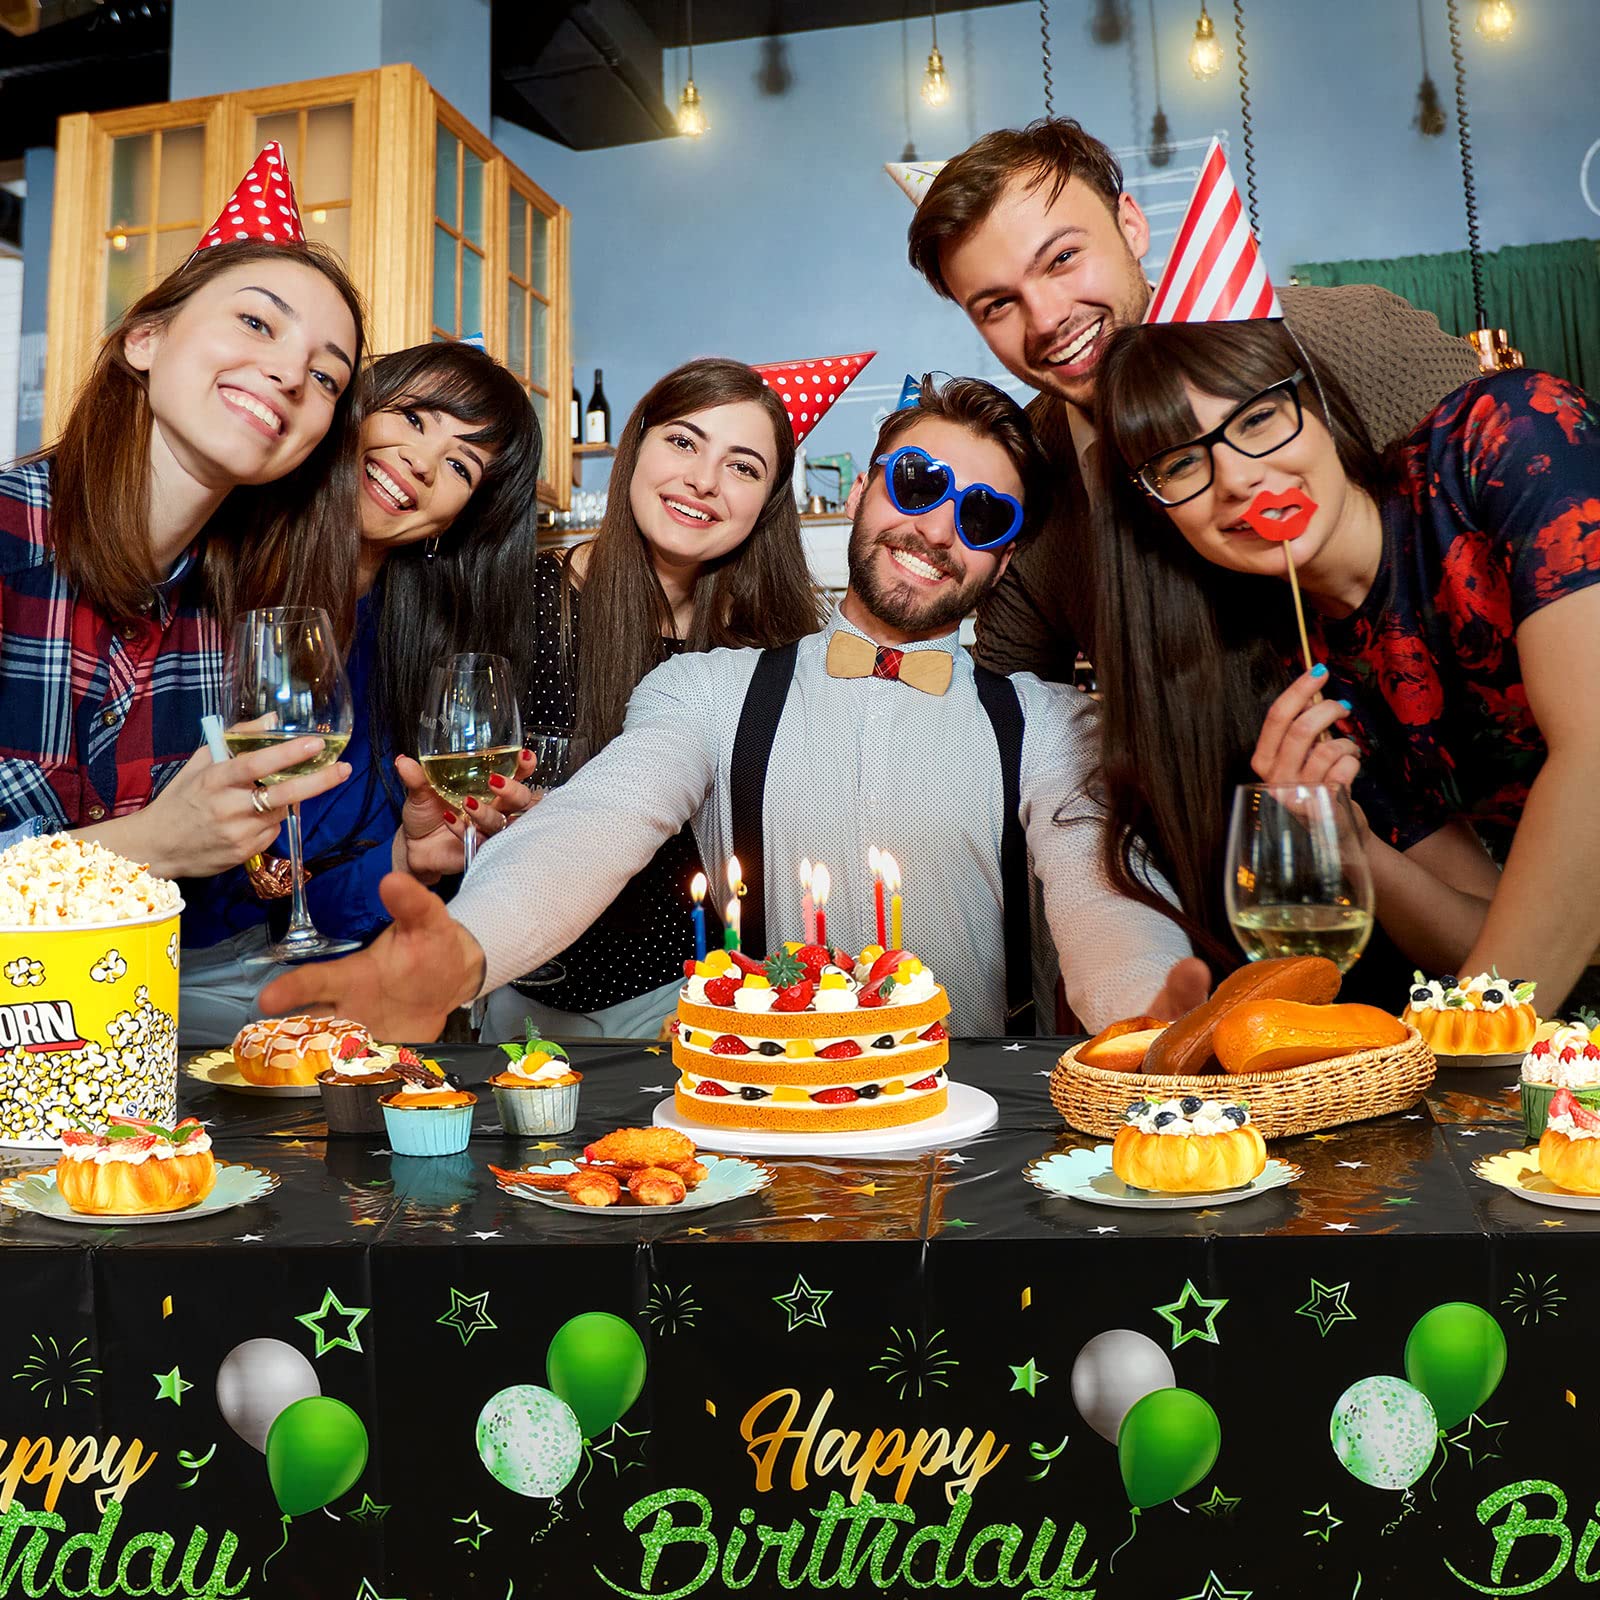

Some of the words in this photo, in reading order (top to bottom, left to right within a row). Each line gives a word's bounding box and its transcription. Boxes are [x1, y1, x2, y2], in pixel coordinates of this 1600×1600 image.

[0, 1435, 159, 1514] ppy
[739, 1387, 1011, 1506] Happy
[0, 1498, 251, 1600] hday
[593, 1487, 1099, 1600] Birthday
